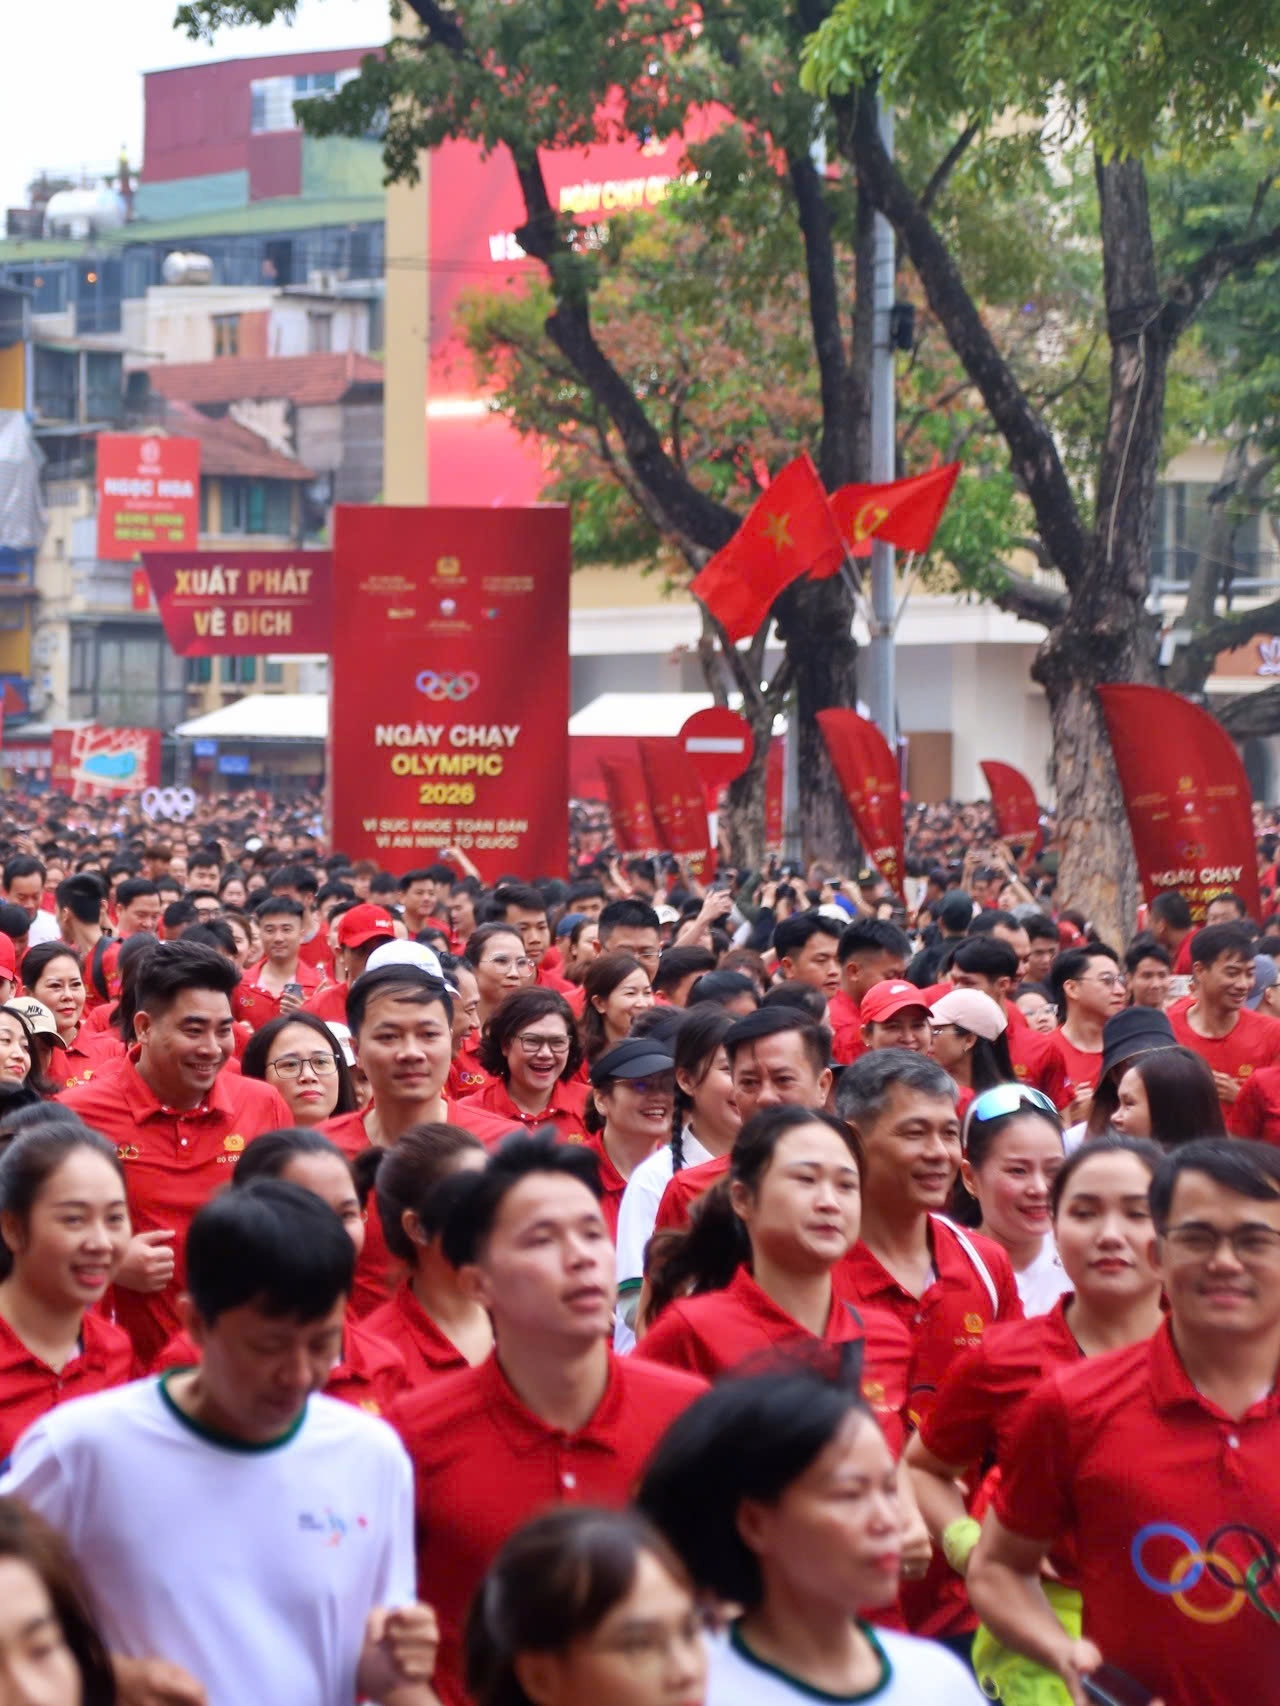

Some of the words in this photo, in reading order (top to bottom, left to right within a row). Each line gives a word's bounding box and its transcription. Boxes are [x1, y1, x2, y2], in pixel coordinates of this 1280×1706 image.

[175, 565, 240, 595] XUẤT
[247, 565, 313, 595] PHÁT
[232, 608, 293, 637] ĐÍCH
[375, 720, 444, 747] NGÀY
[449, 723, 521, 750] CHẠY
[391, 753, 504, 776] OLYMPIC
[419, 782, 477, 805] 2026
